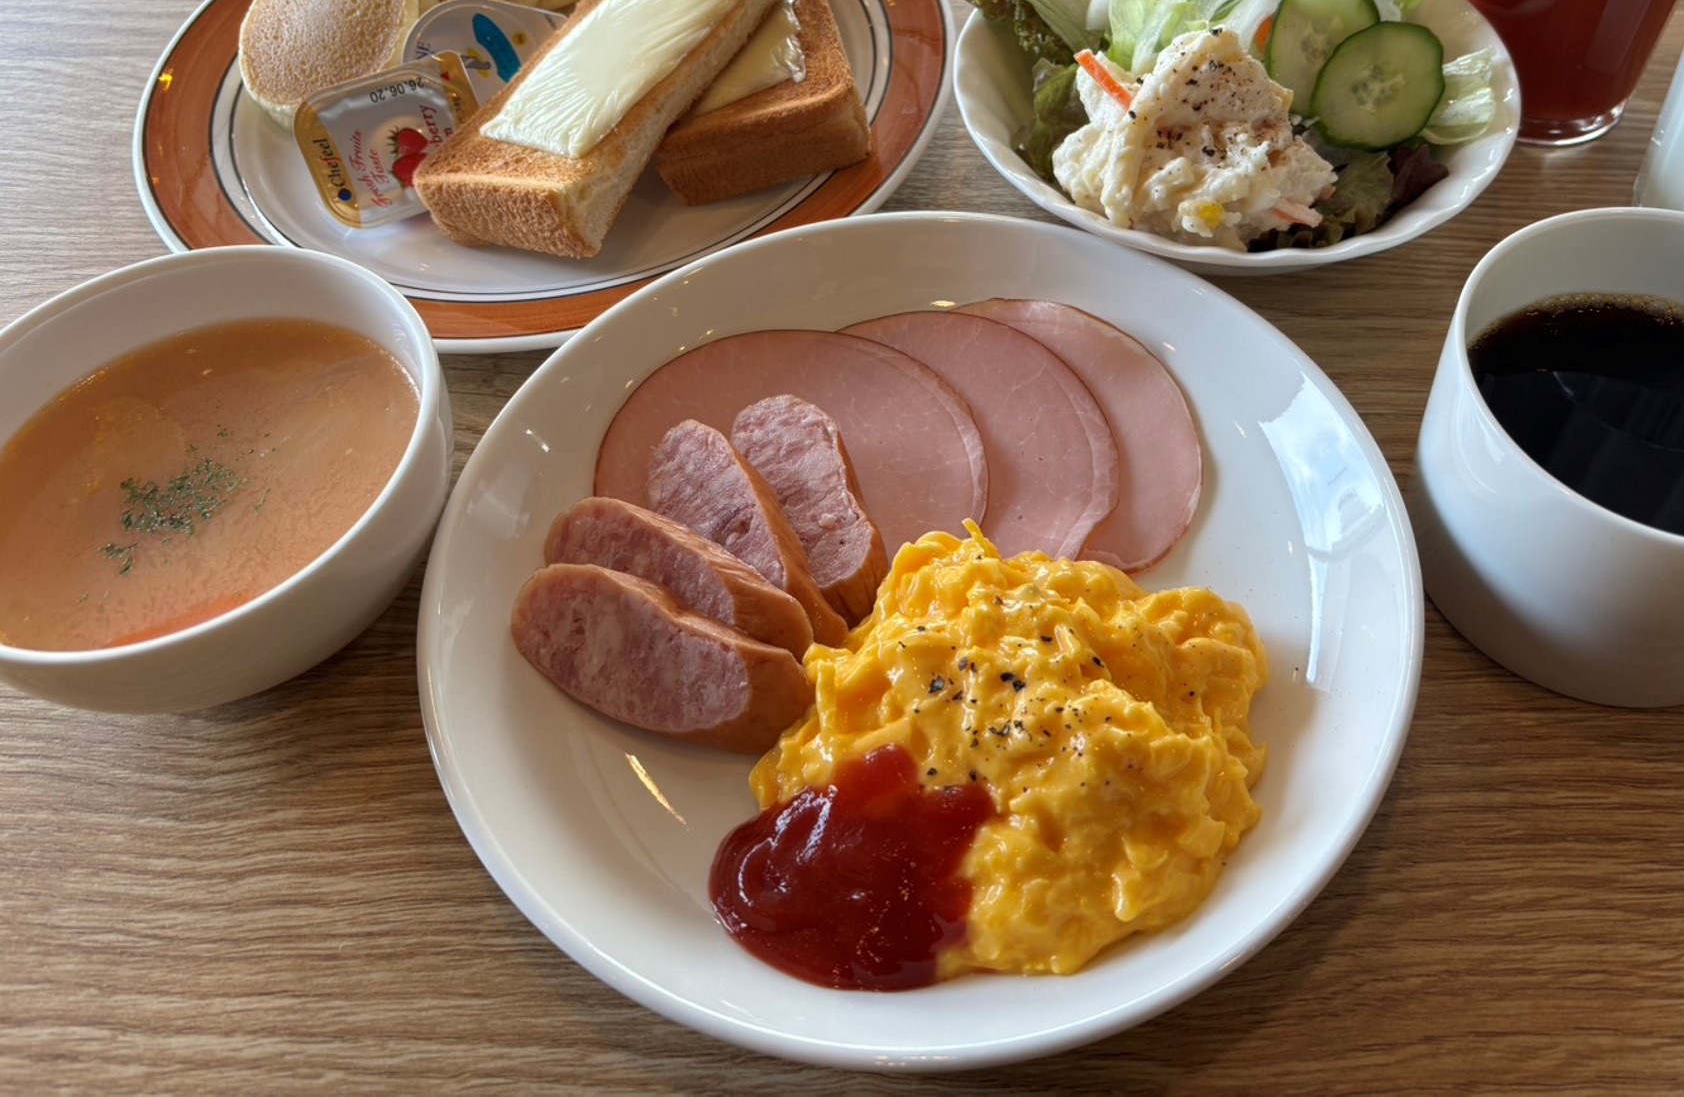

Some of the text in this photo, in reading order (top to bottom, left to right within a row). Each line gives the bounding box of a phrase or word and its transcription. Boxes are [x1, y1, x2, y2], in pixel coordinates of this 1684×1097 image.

[369, 76, 425, 104] 26.06.20
[313, 138, 343, 187] Chefeel
[348, 128, 391, 209] Fresh Fruits
